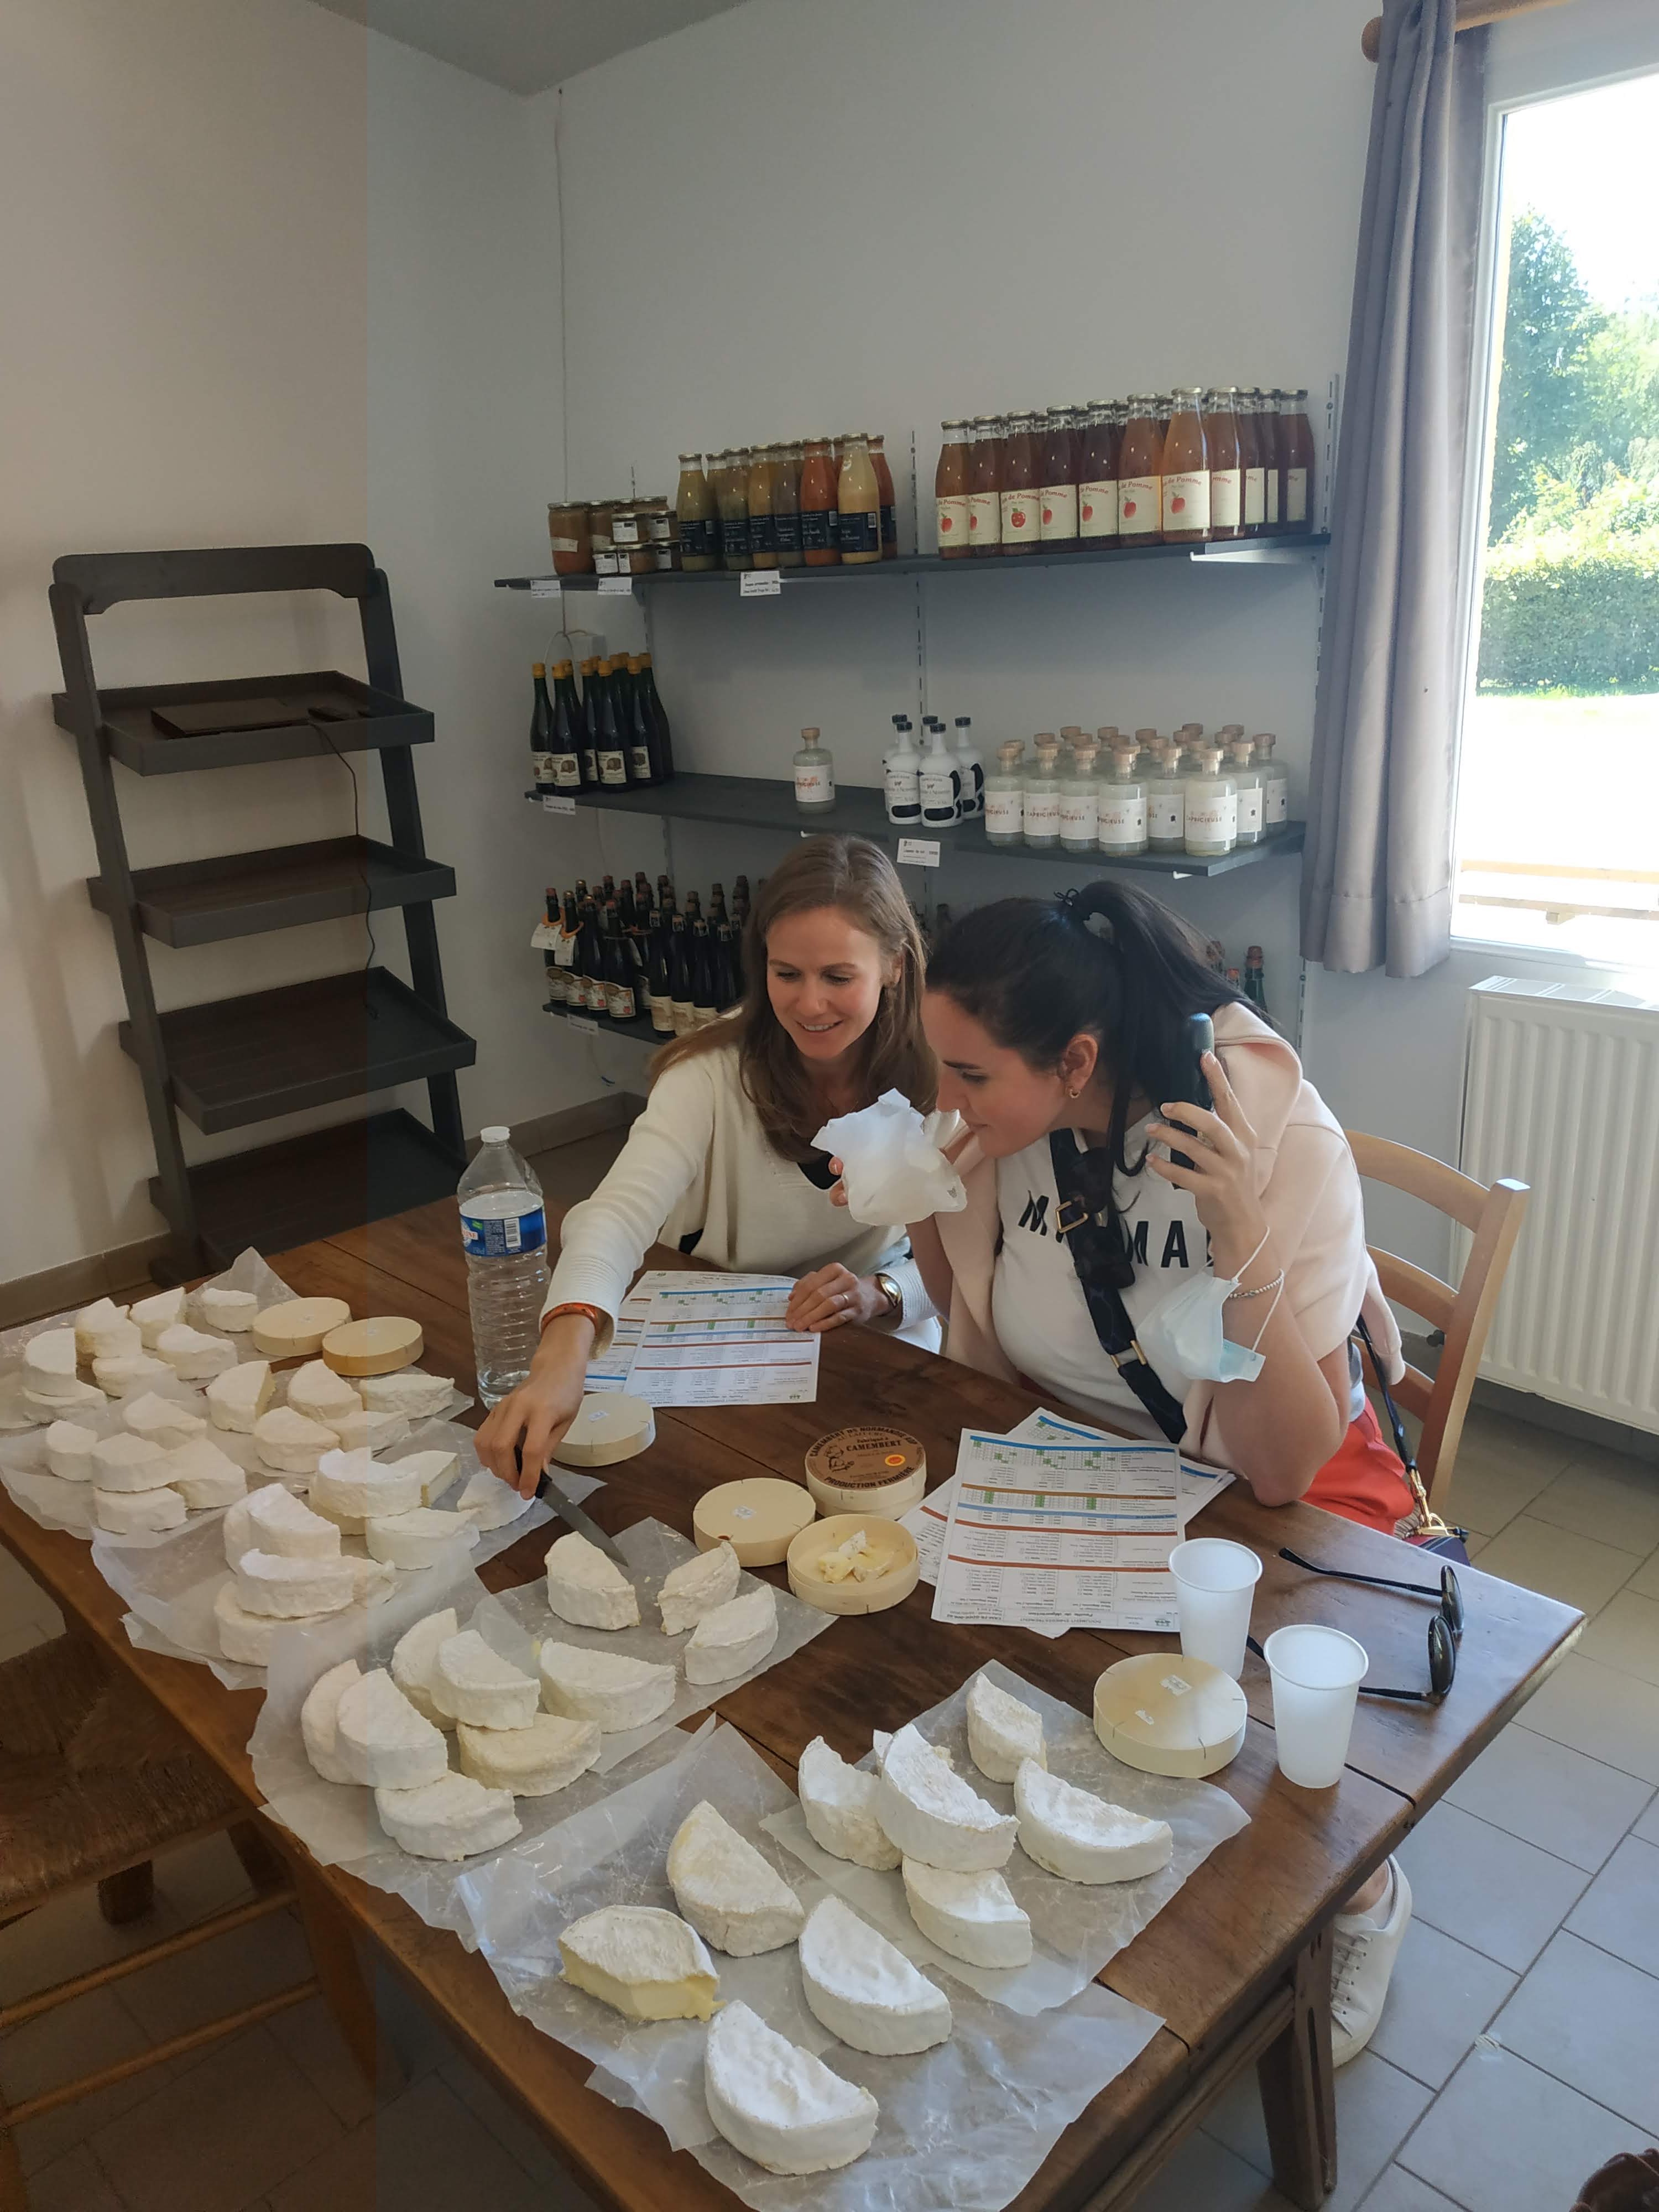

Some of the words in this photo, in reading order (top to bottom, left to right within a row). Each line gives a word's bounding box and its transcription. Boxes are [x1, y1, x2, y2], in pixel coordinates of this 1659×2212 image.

[1128, 481, 1153, 490] Pomme
[1176, 476, 1202, 486] Pomme
[1045, 490, 1067, 498] Pomme
[1086, 486, 1109, 494] Pomme
[1017, 493, 1040, 501] Pomme
[810, 1431, 844, 1457] CAMEMBERT
[846, 1440, 901, 1451] CAMEMBERT
[824, 1476, 876, 1489] PRODUCTION
